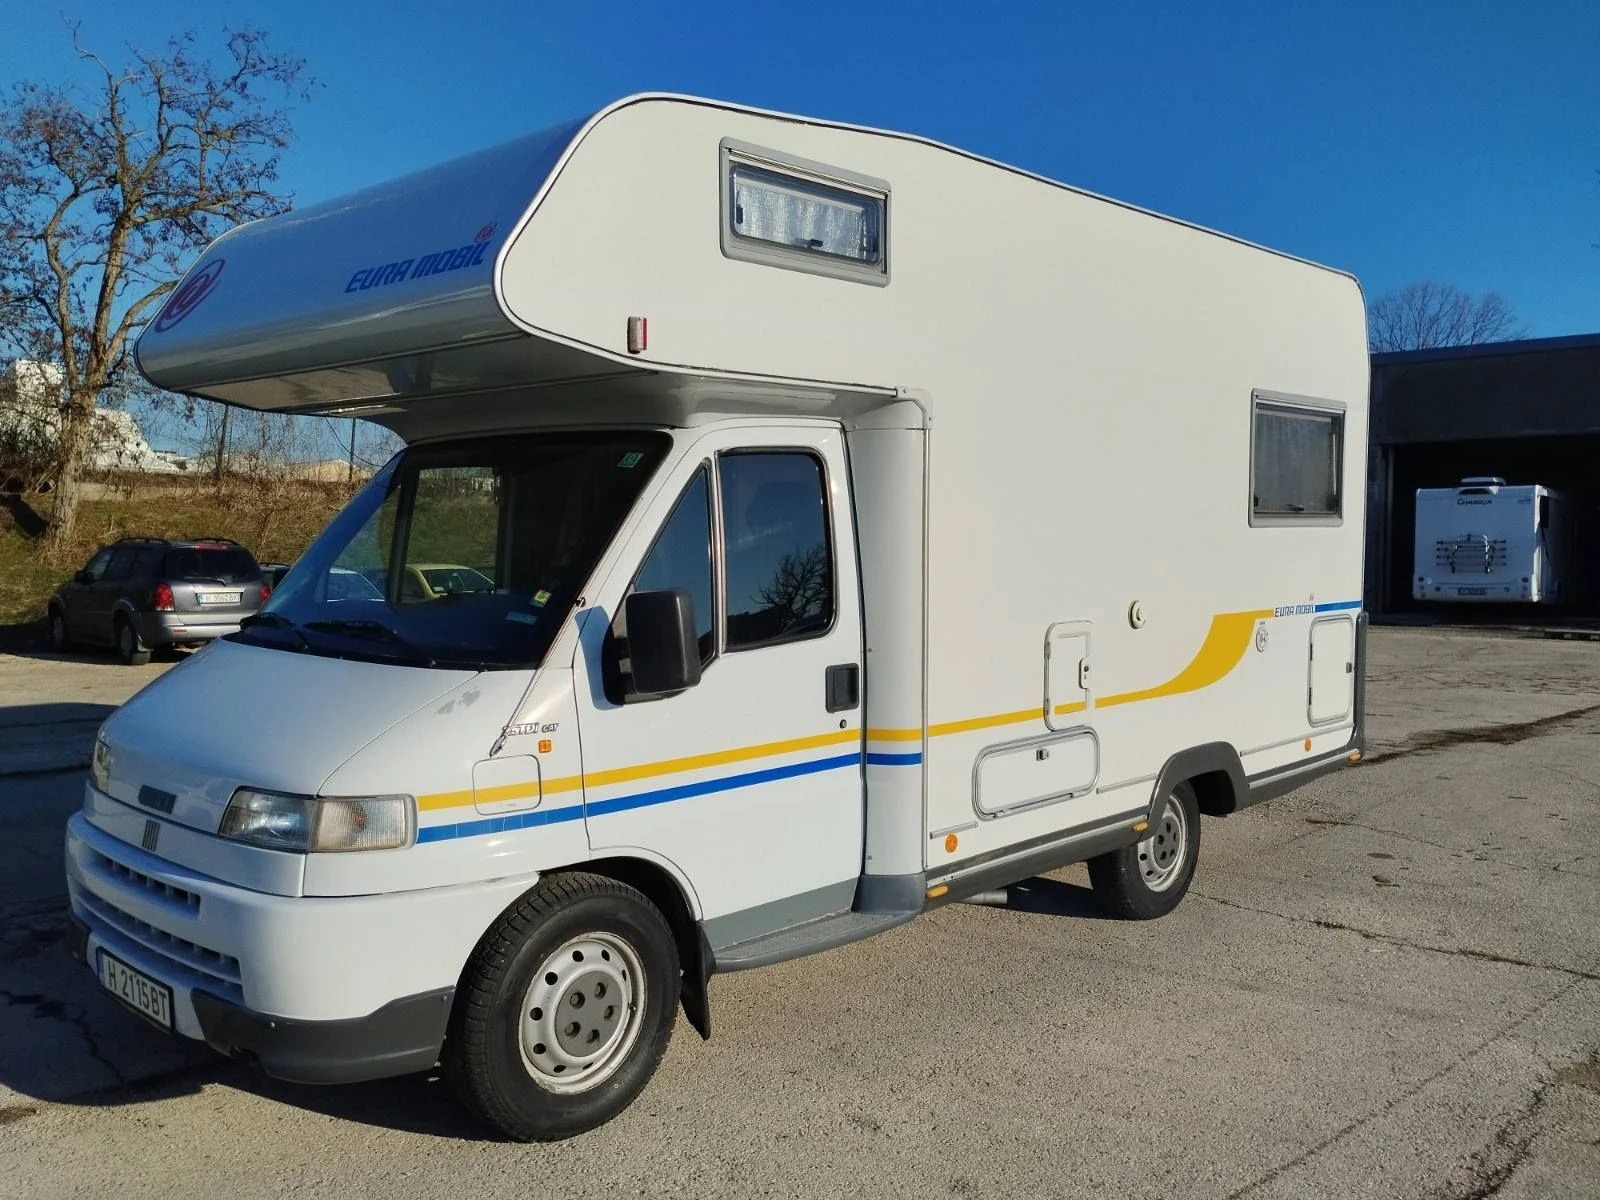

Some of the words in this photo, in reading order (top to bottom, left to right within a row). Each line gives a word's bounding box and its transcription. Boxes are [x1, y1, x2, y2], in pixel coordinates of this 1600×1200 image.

[345, 258, 415, 293] EURA
[410, 241, 491, 280] MOBIL
[1274, 606, 1295, 617] EURA
[541, 723, 559, 733] CAT
[108, 960, 117, 990] H
